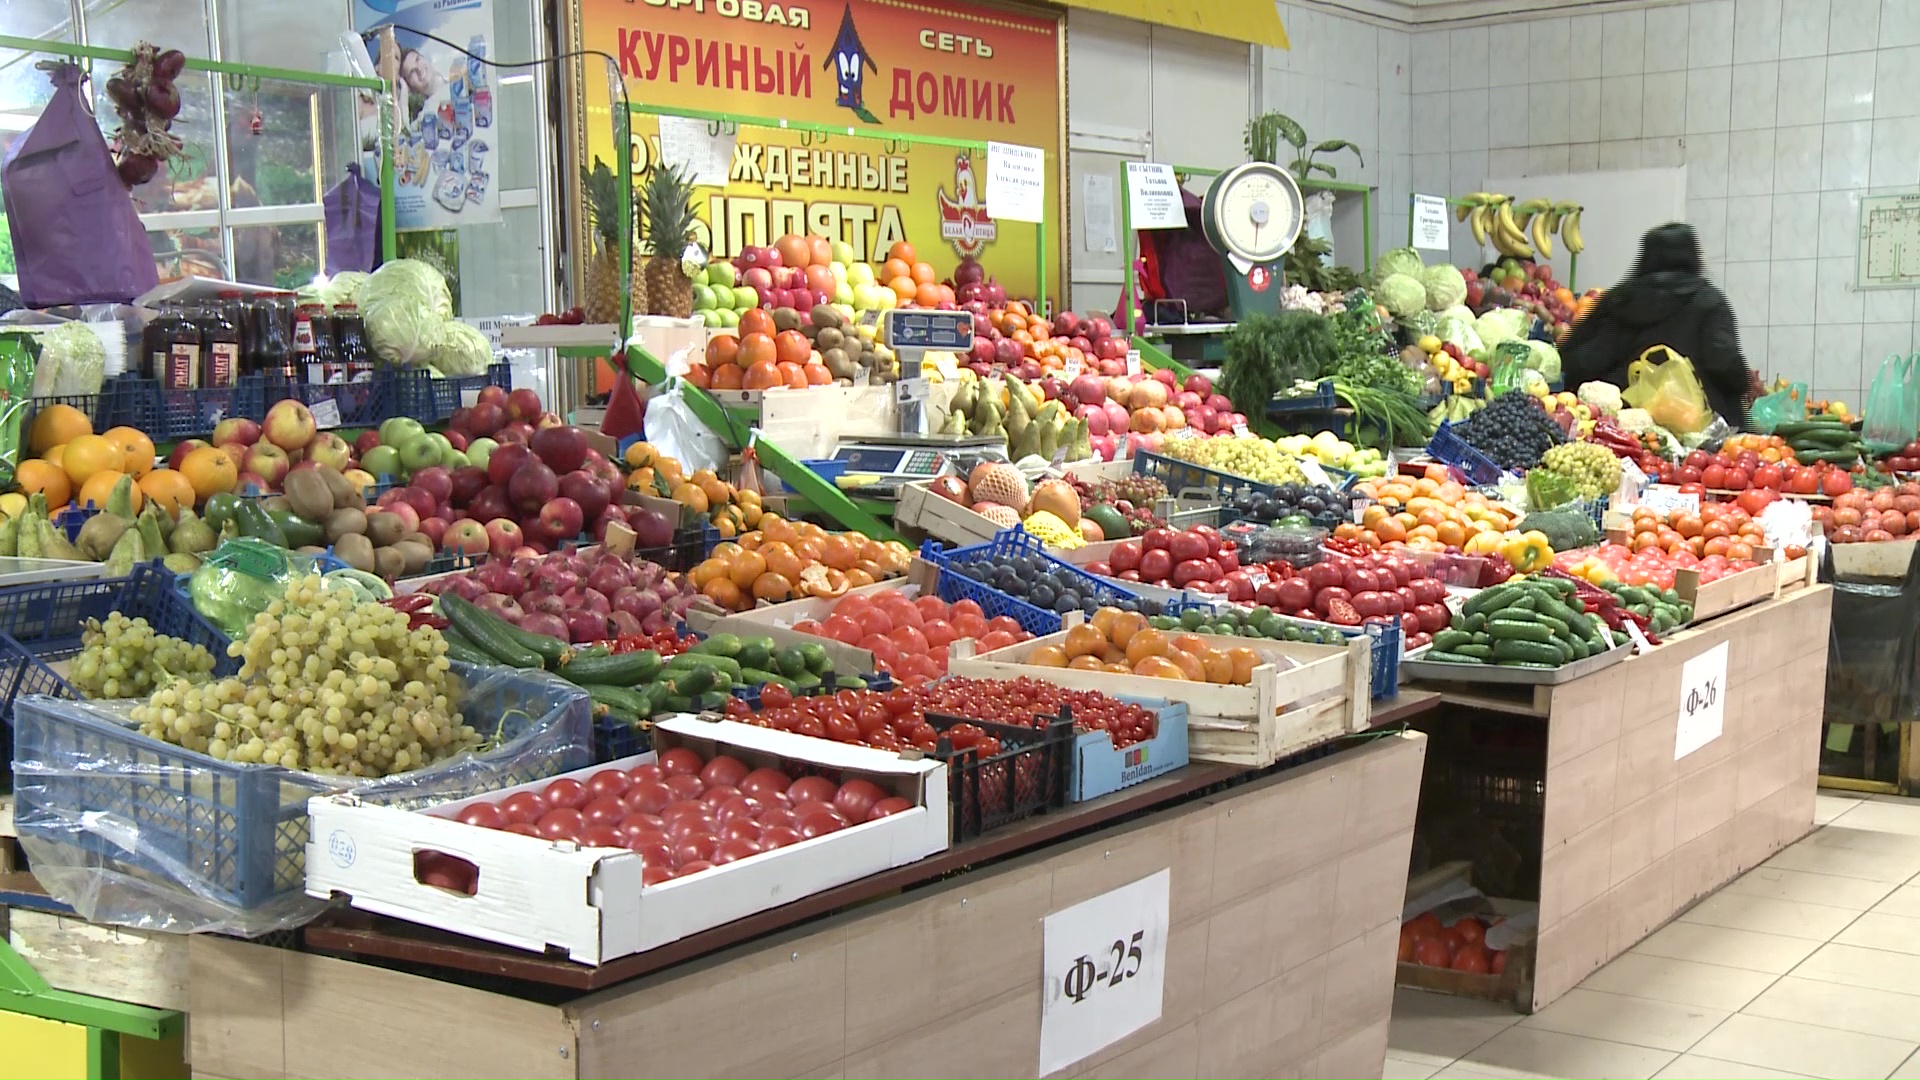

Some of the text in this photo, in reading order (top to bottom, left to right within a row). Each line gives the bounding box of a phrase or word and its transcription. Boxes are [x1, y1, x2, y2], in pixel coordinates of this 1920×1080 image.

[626, 0, 811, 29] ГОВАЯ
[617, 26, 812, 99] КУРИНЫЙ
[919, 29, 994, 59] СЕТЬ
[889, 68, 1016, 124] ДОМИК
[630, 131, 909, 194] ОЖДЕННЫЕ
[1686, 676, 1718, 717] Ф-26
[1121, 764, 1153, 783] BenIdan
[1064, 929, 1144, 1005] Ф-25
